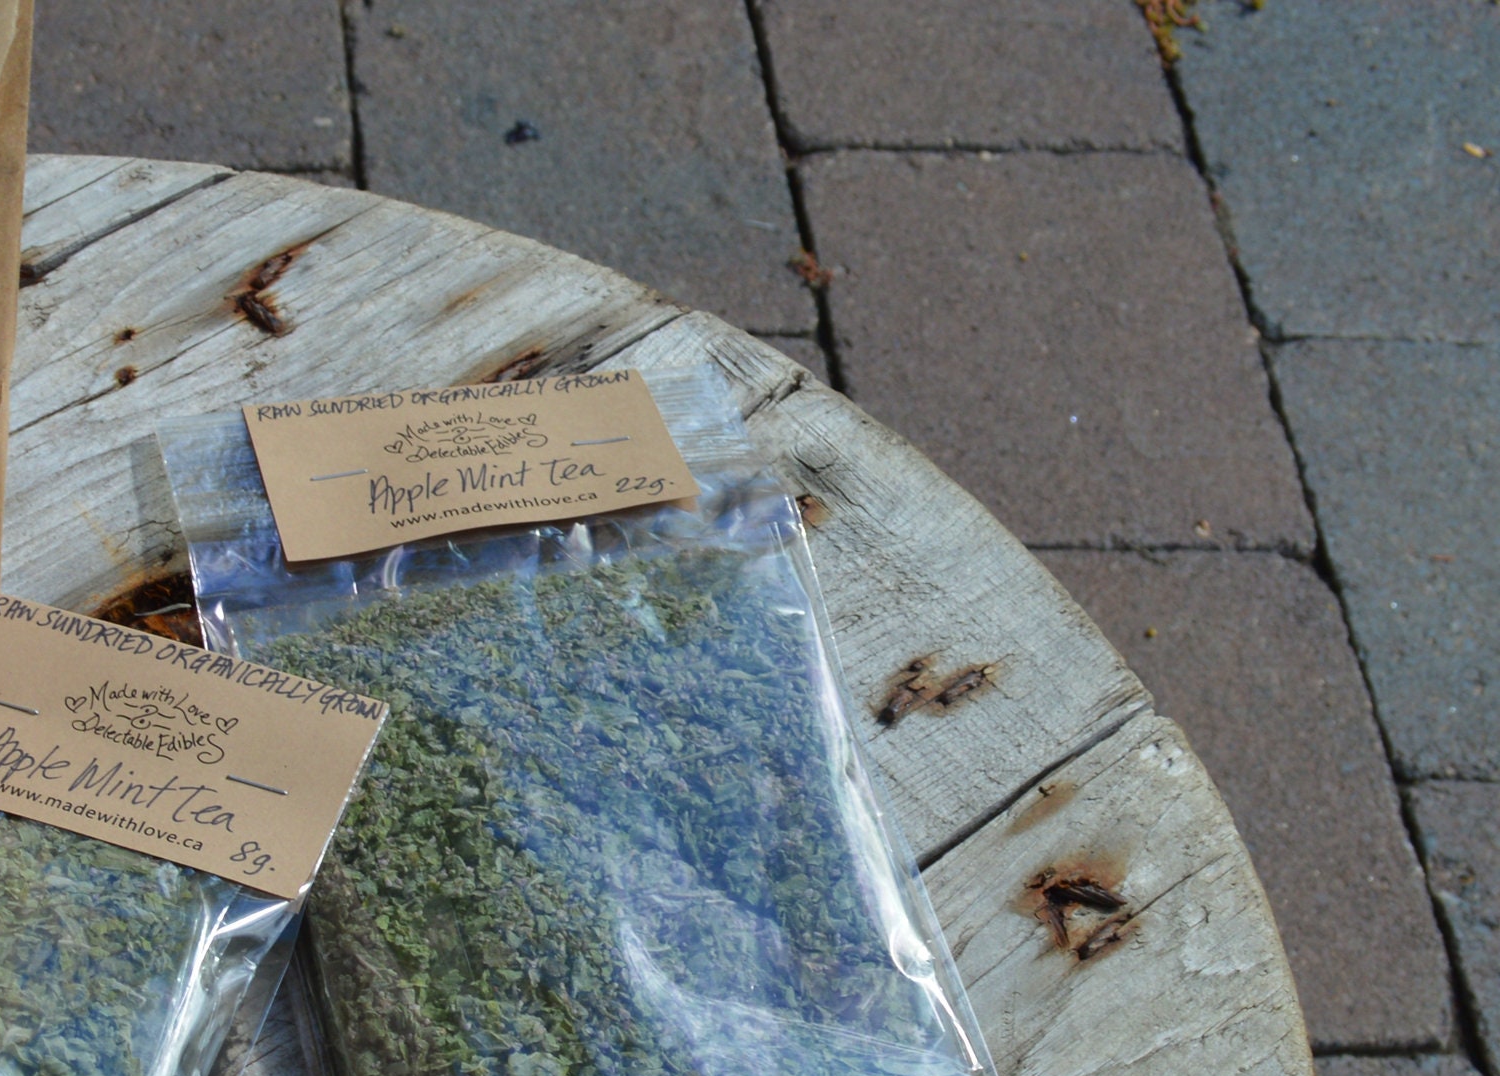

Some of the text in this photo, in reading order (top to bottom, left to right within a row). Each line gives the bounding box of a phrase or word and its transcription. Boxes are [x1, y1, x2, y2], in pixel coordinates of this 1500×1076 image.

[256, 369, 631, 422] RAW SUNDRIED ORGANICALLY GROWN
[396, 411, 516, 446] Made with Love
[405, 444, 490, 463] Delectable
[369, 458, 605, 515] Apple Mint Tea
[390, 490, 598, 529] www.madewithlove.ca
[36, 610, 153, 655] SUNDRIED
[155, 643, 327, 704] ORGANICALLY
[319, 687, 386, 722] GROWN
[89, 680, 211, 726] Made with Love
[71, 712, 154, 751] Delectable
[68, 757, 180, 808] Mint
[178, 785, 235, 833] Tea
